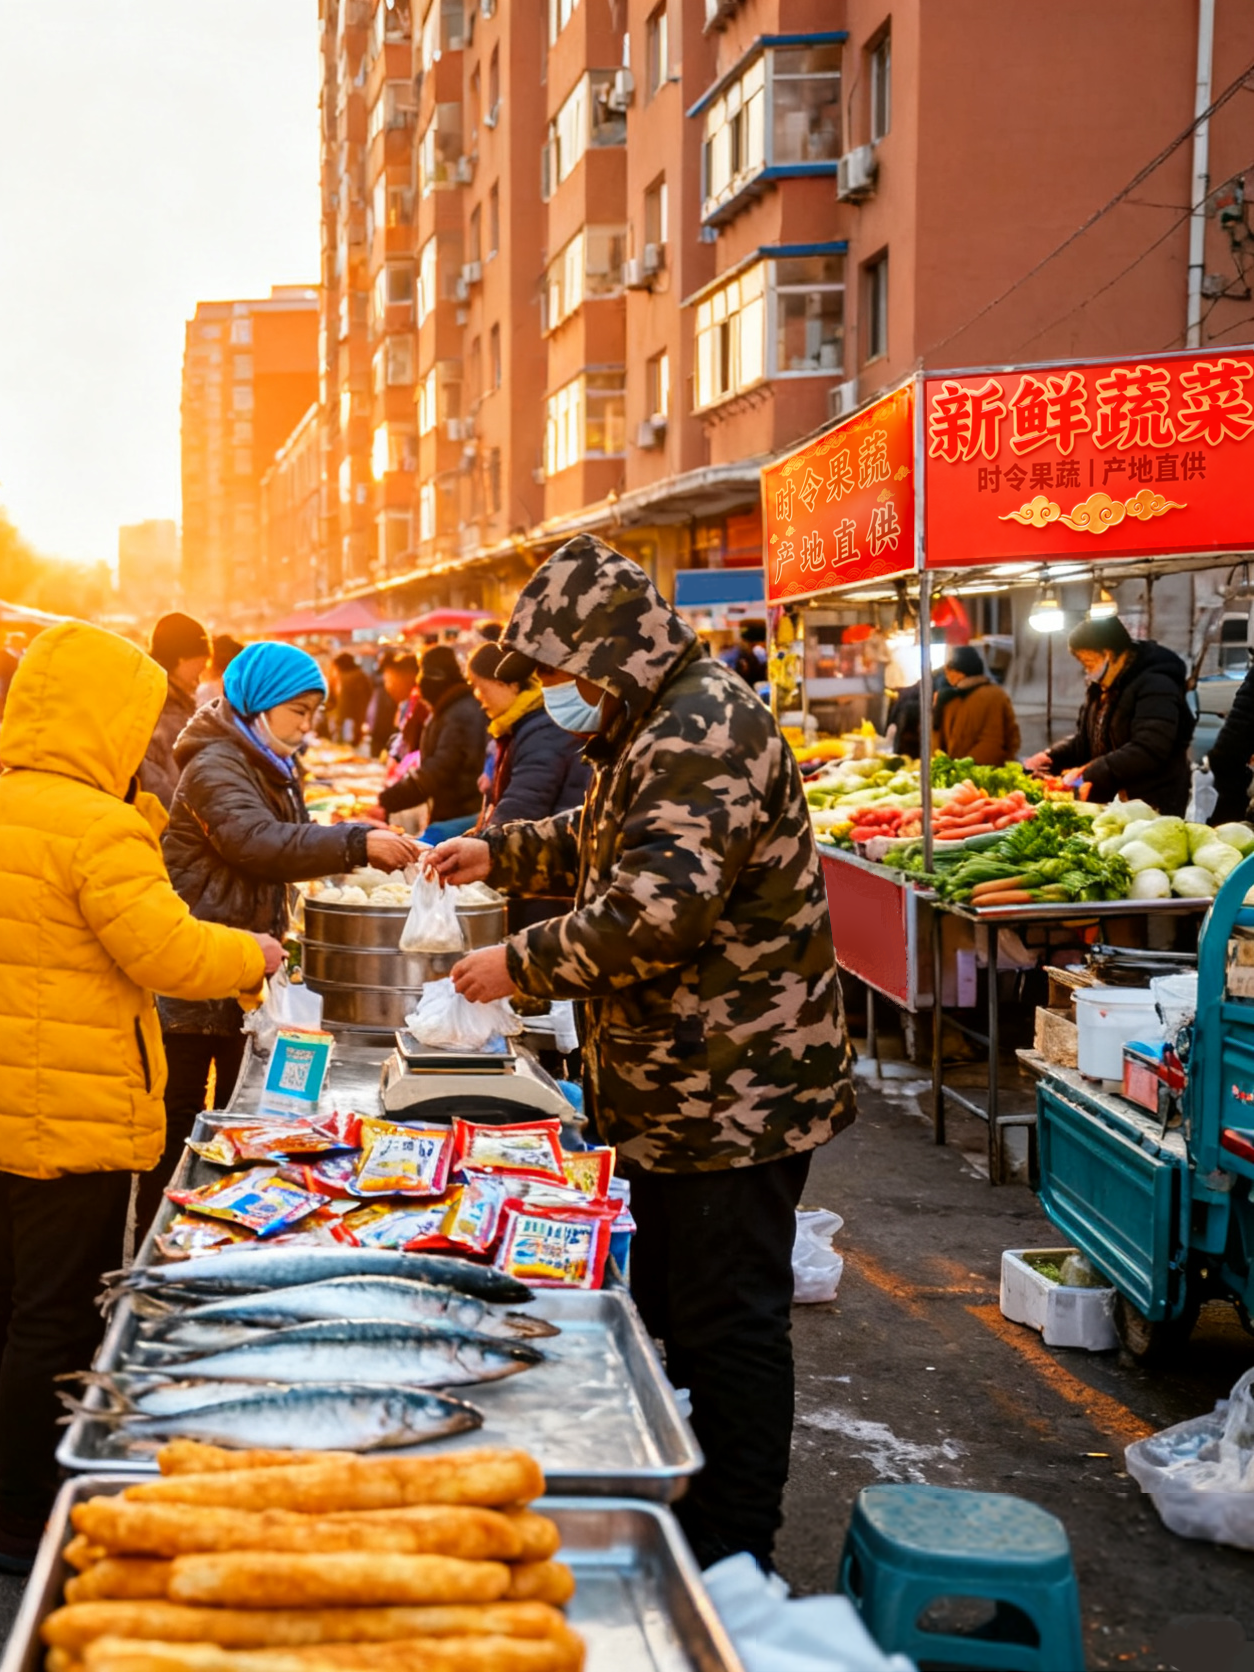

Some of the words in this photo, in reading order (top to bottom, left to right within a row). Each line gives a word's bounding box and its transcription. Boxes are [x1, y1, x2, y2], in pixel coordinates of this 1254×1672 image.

[929, 358, 1254, 463] 新鲜蔬菜
[775, 430, 891, 521] 时令果蔬
[775, 502, 901, 585] 产地直供
